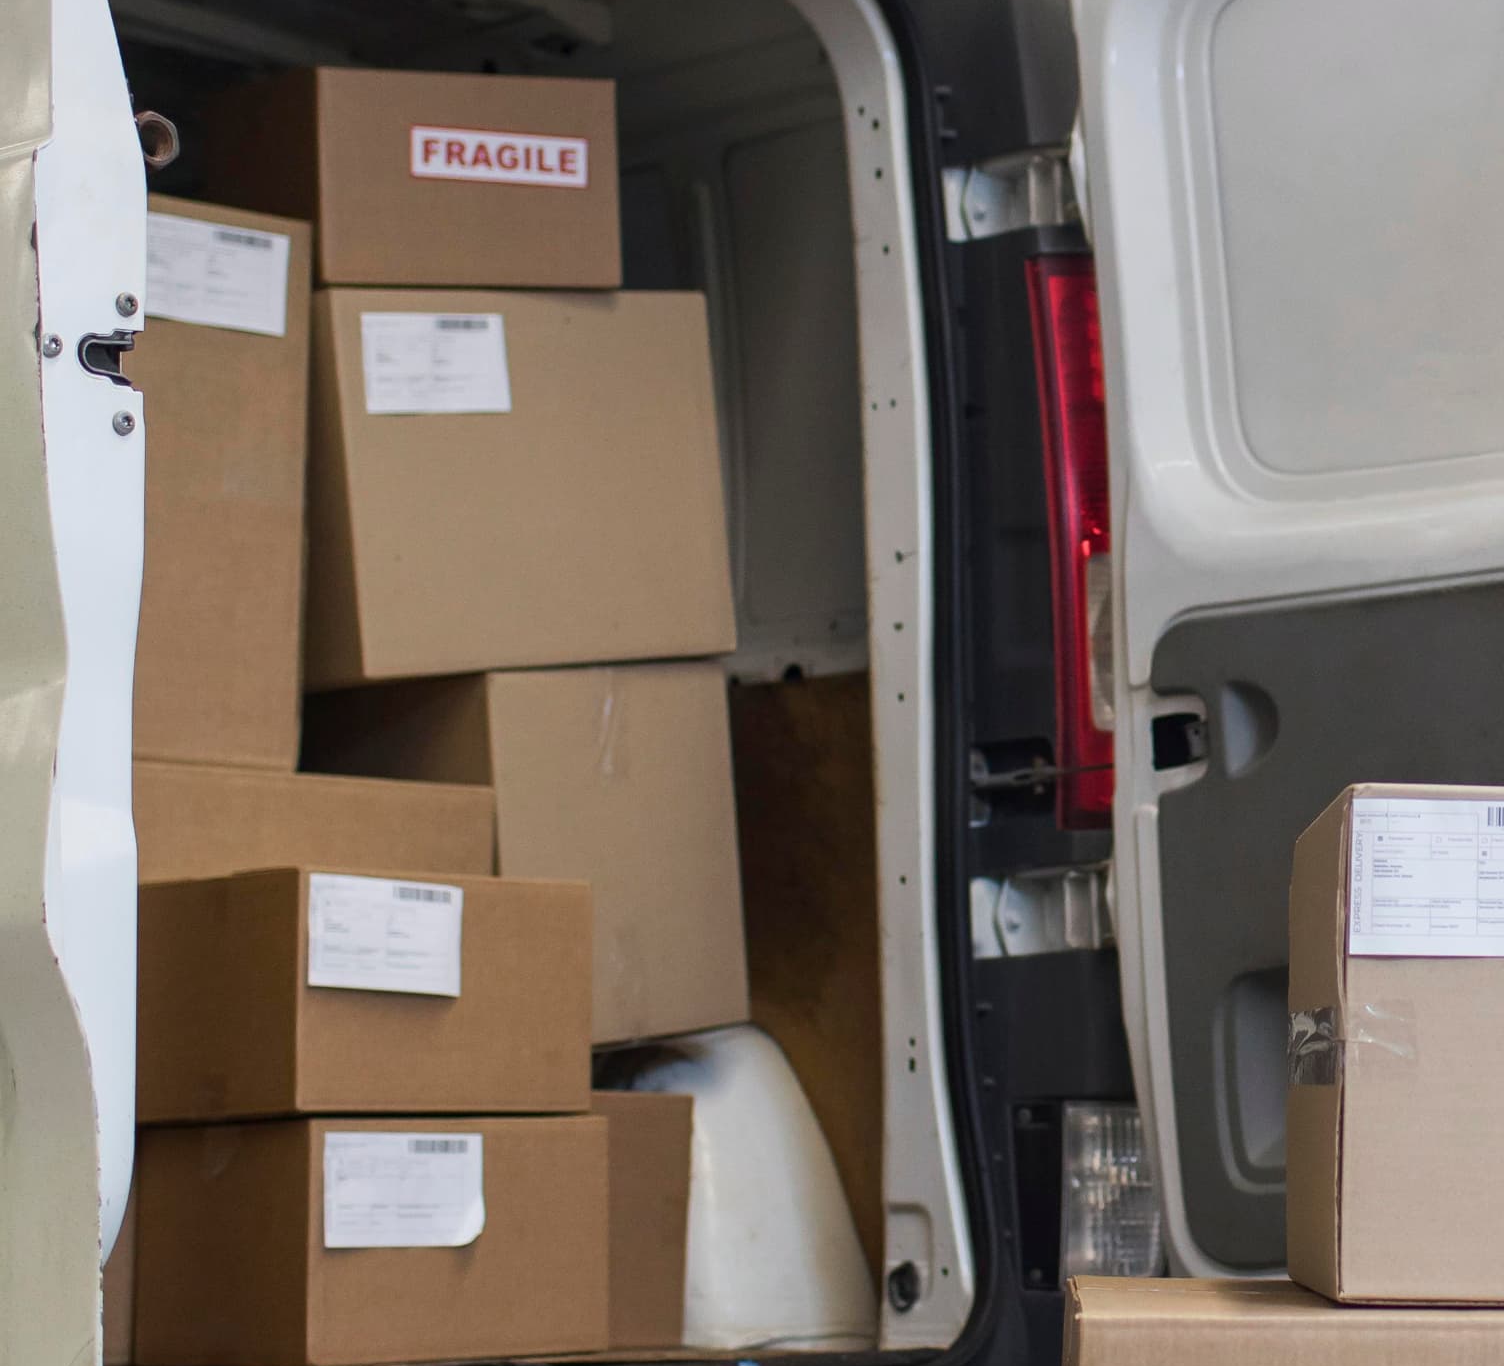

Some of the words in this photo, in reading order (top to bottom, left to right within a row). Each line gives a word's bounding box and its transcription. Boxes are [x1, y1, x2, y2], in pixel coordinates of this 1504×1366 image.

[422, 138, 578, 175] FRAGILE
[1354, 831, 1364, 883] DELIVERY
[1353, 887, 1363, 932] EXPRESS
